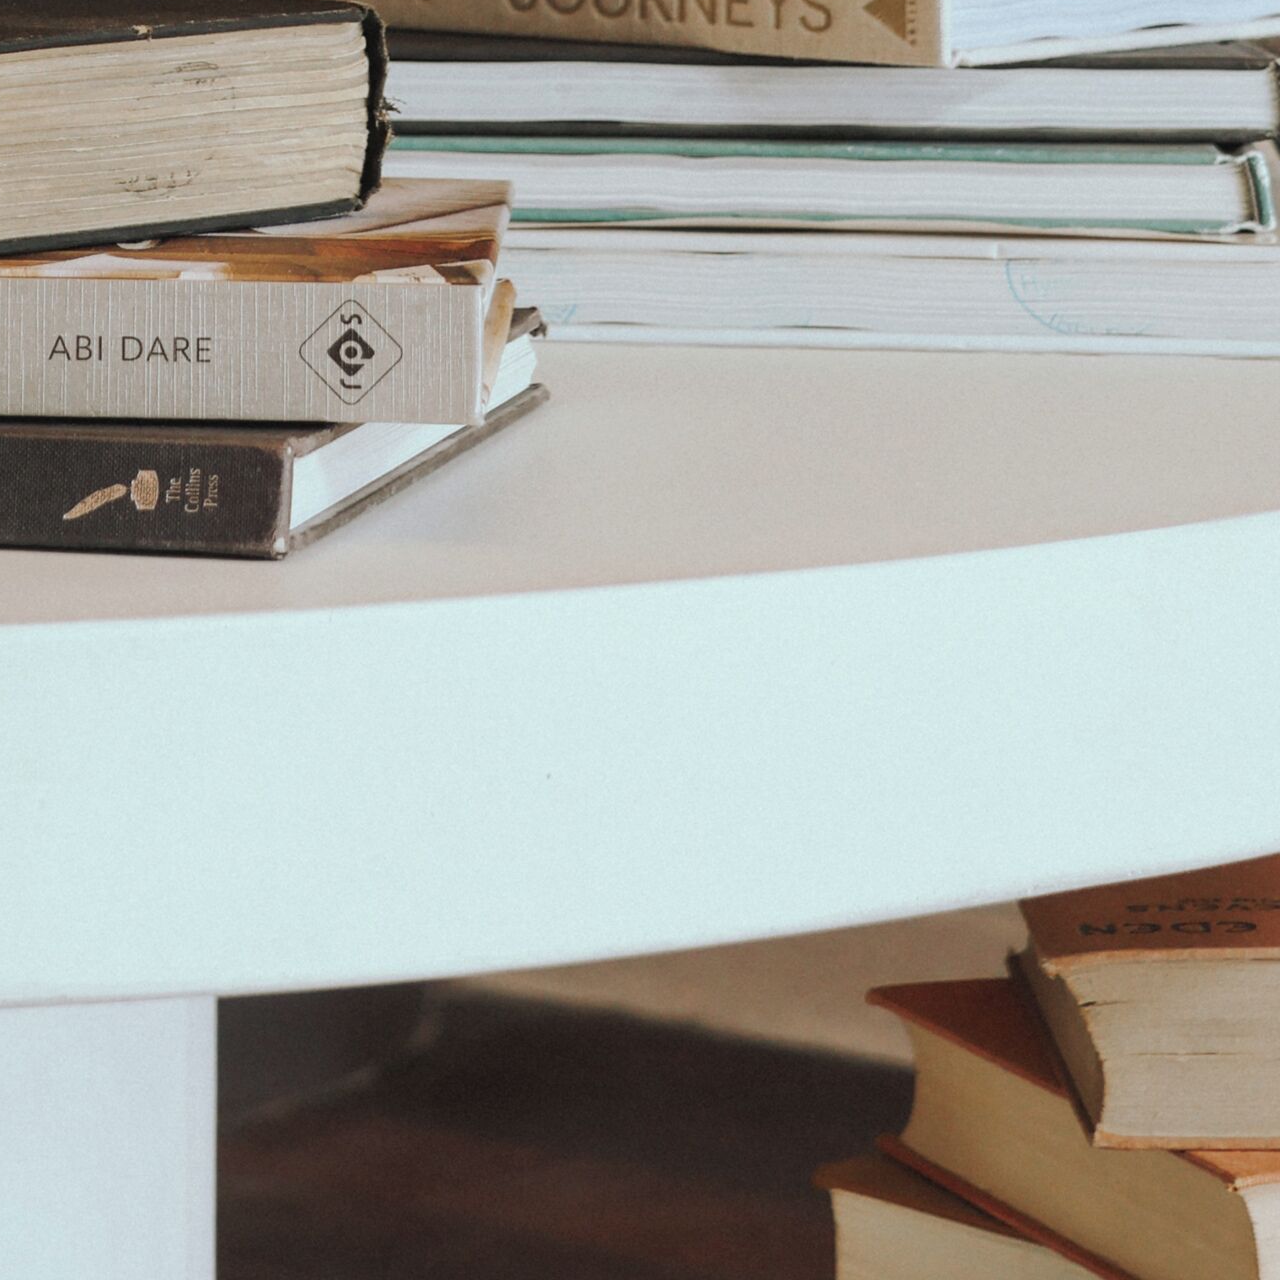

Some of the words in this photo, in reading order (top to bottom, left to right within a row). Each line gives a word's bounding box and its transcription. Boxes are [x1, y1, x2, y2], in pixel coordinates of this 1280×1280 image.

[48, 334, 103, 361] ABI
[122, 335, 212, 363] DARE
[165, 476, 182, 504] The
[184, 467, 201, 513] Collins
[203, 474, 219, 507] Press
